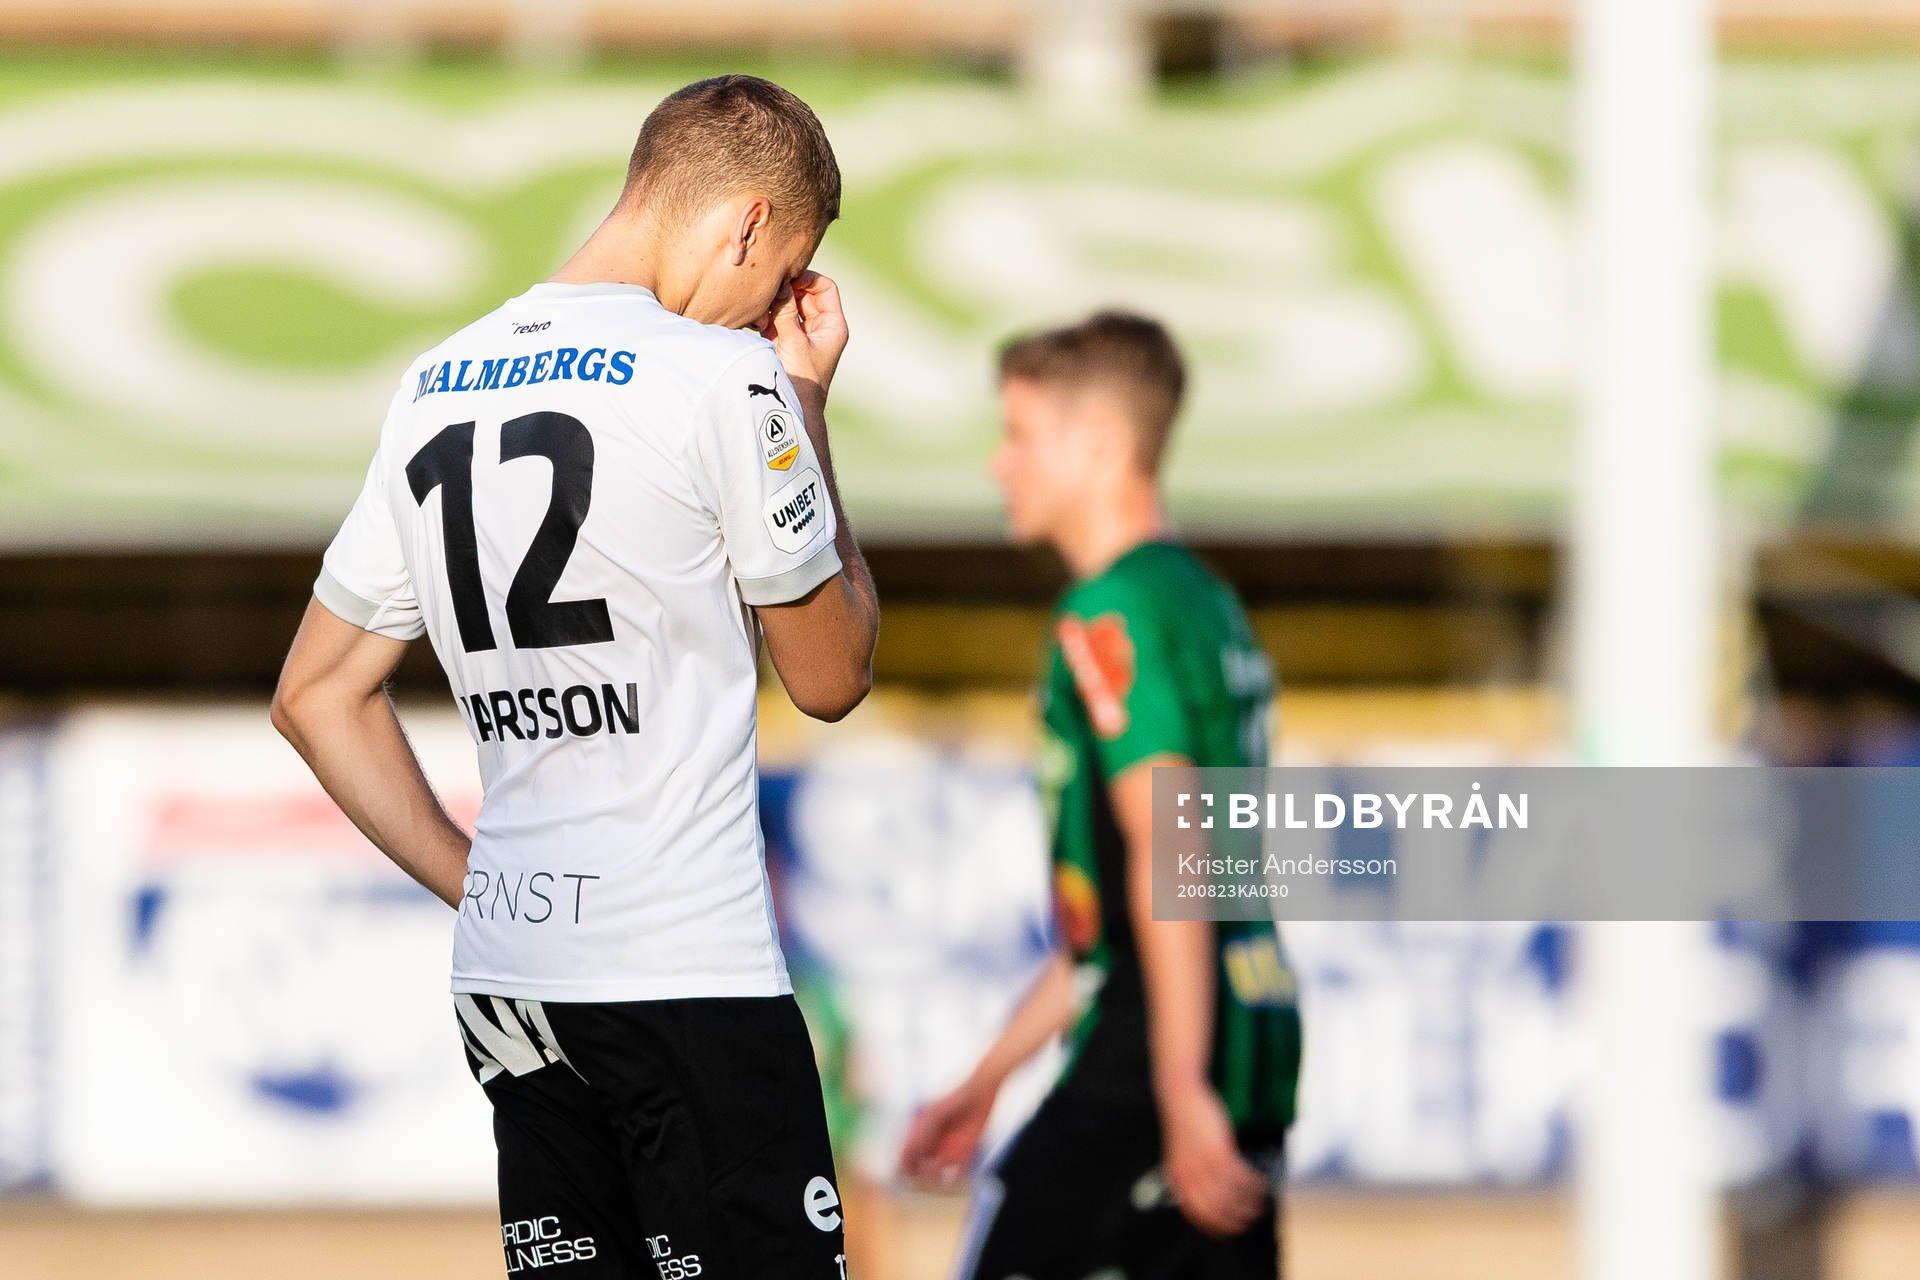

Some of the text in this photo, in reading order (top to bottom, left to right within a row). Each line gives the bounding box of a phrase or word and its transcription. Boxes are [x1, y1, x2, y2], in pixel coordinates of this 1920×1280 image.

[511, 320, 552, 335] rebro
[412, 347, 637, 405] MALMBERGS
[772, 481, 817, 528] UNIBET
[405, 411, 615, 654] 12
[460, 682, 640, 745] ARSSON
[462, 870, 601, 924] RNST
[501, 1216, 562, 1247] RDIC
[507, 1237, 597, 1272] LNESS
